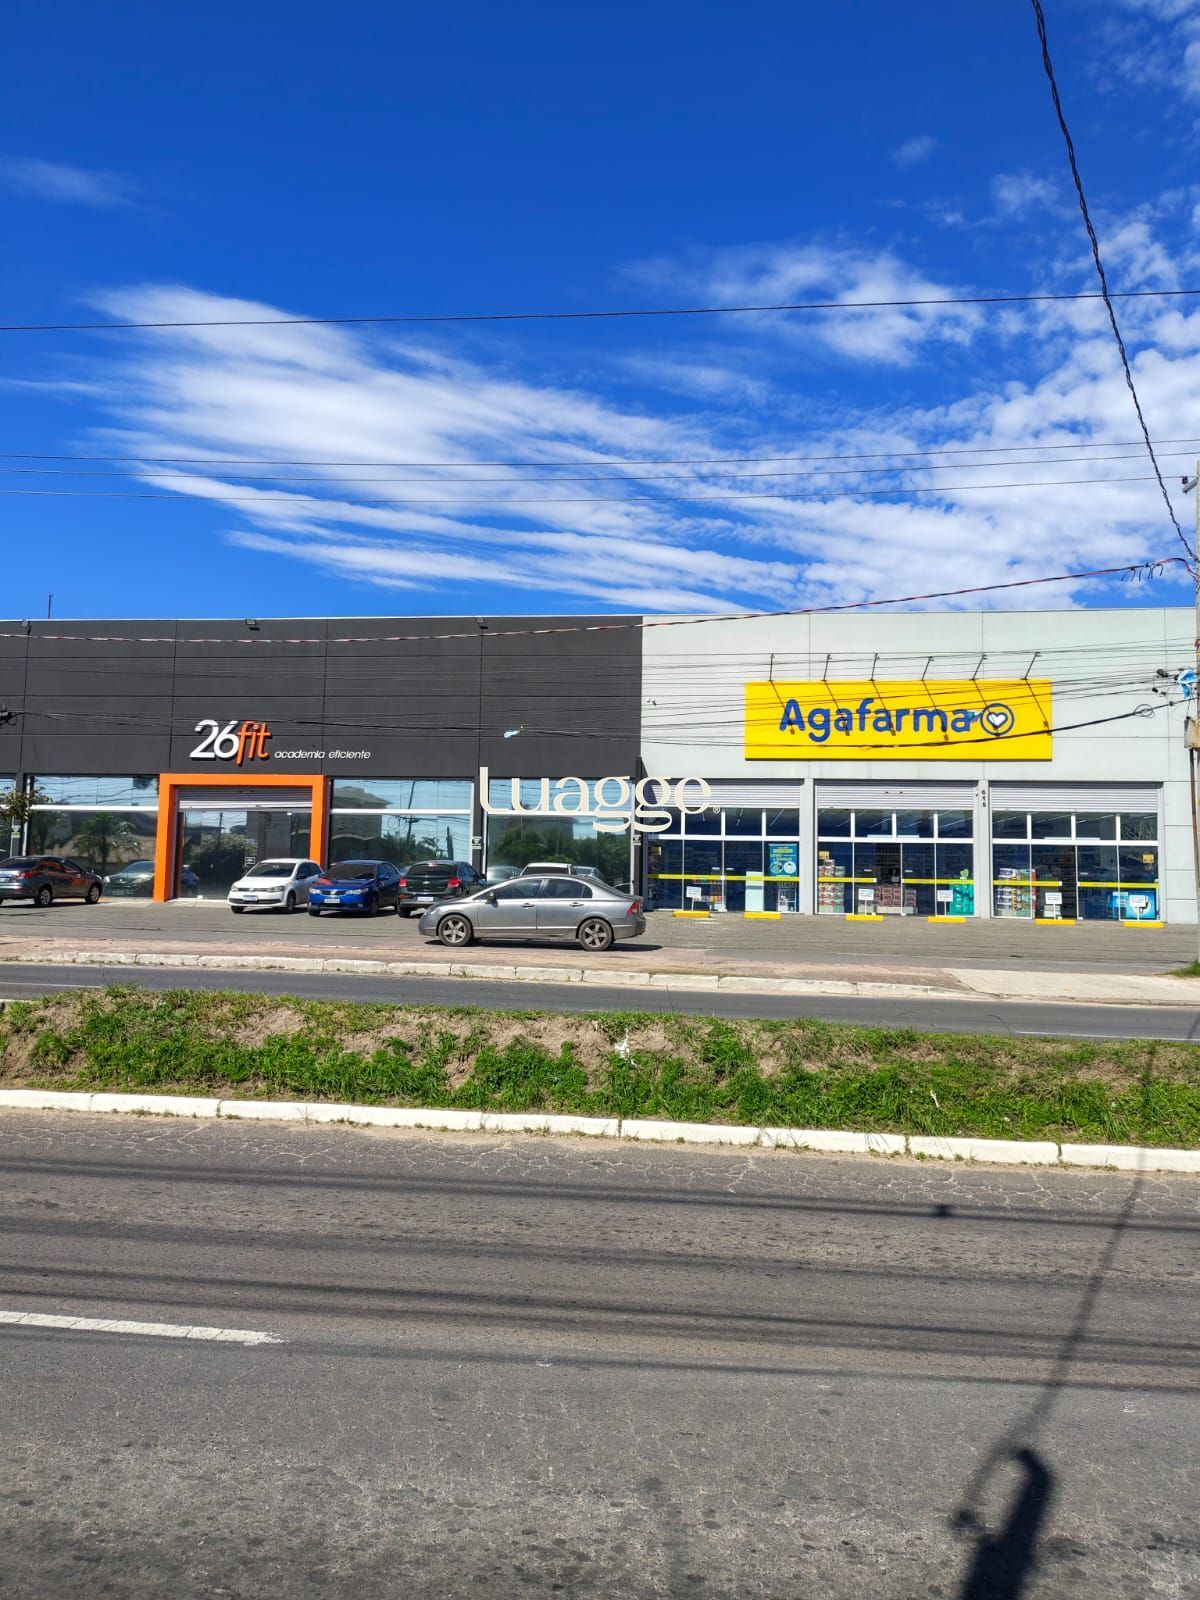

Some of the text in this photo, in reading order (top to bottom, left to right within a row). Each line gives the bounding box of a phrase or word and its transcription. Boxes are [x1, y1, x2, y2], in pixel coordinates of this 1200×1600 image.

[779, 698, 971, 742] Agafarma
[274, 749, 371, 759] academia eficiente
